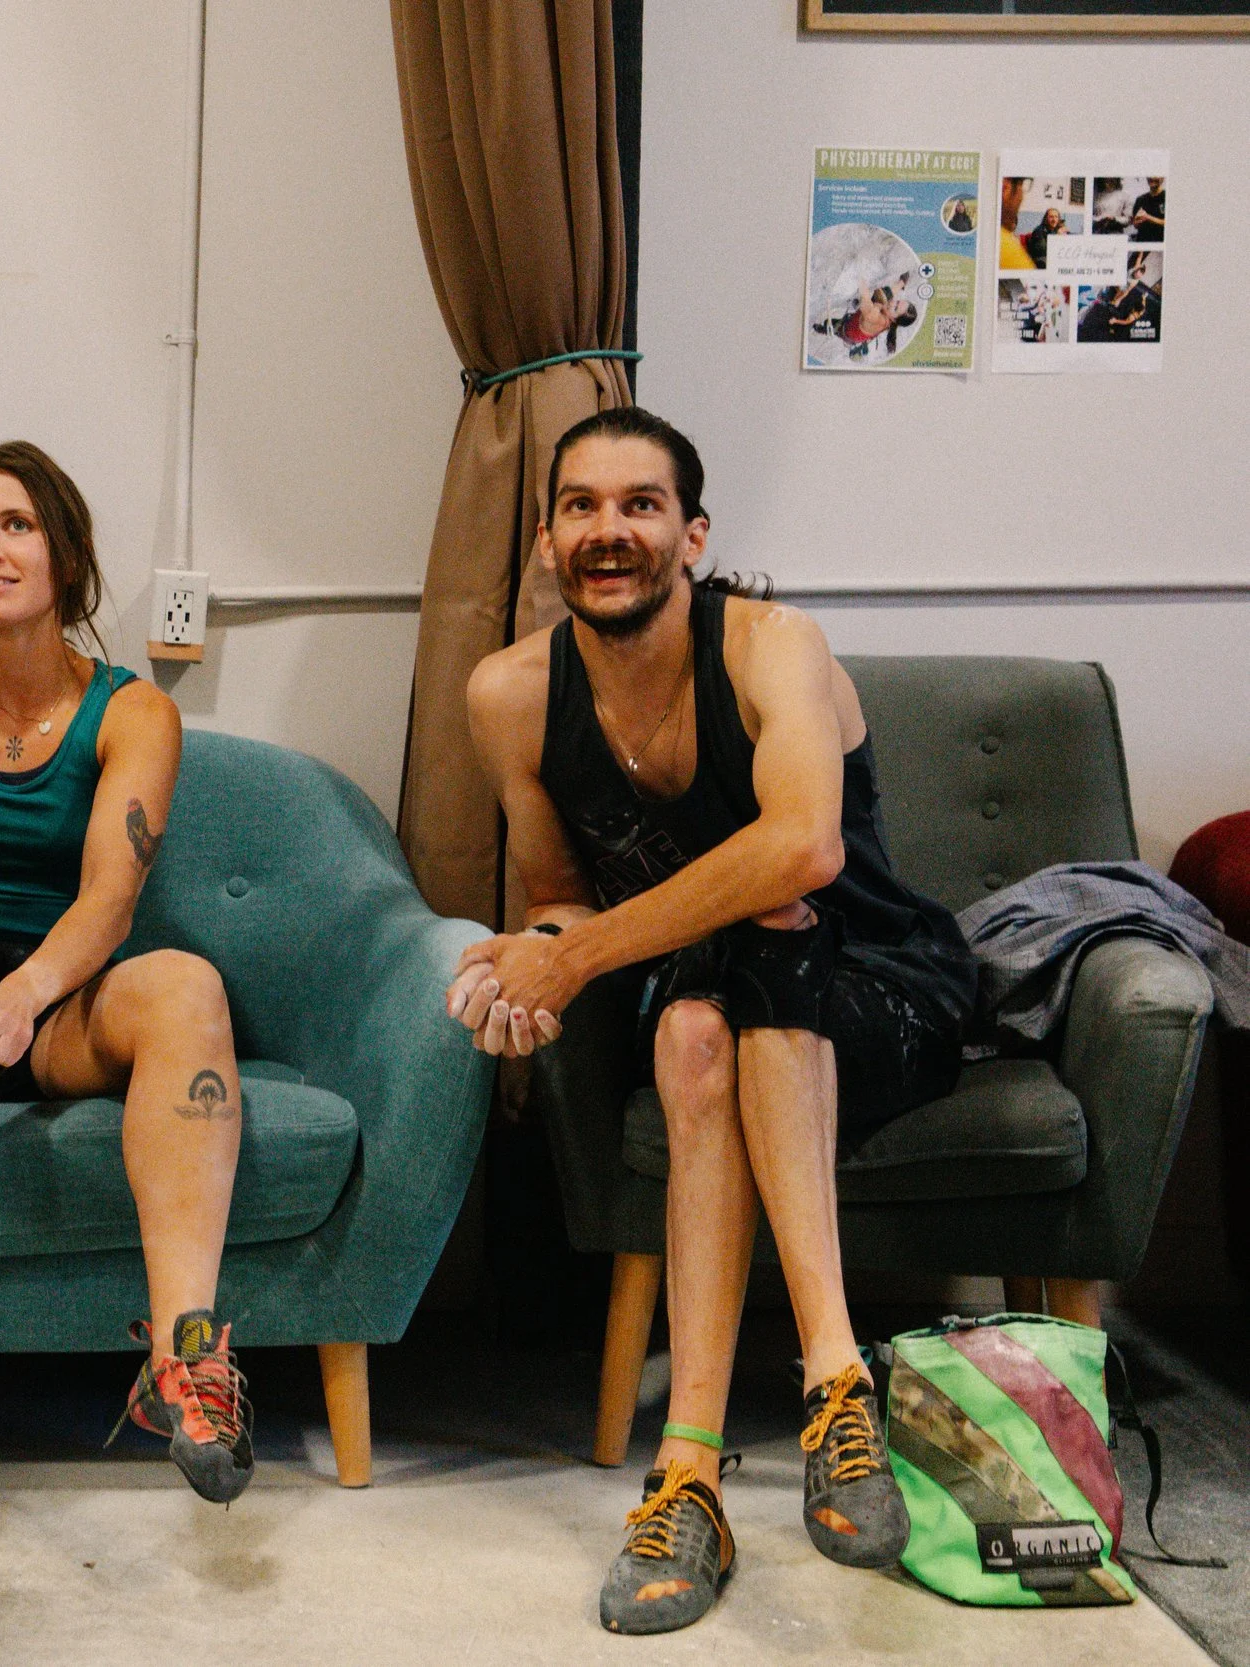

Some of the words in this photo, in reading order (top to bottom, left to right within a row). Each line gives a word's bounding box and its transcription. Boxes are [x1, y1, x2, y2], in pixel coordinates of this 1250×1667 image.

[820, 150, 930, 169] PHYSIOTHERAPY
[933, 154, 947, 169] AT
[991, 1537, 1097, 1557] ORGANIC
